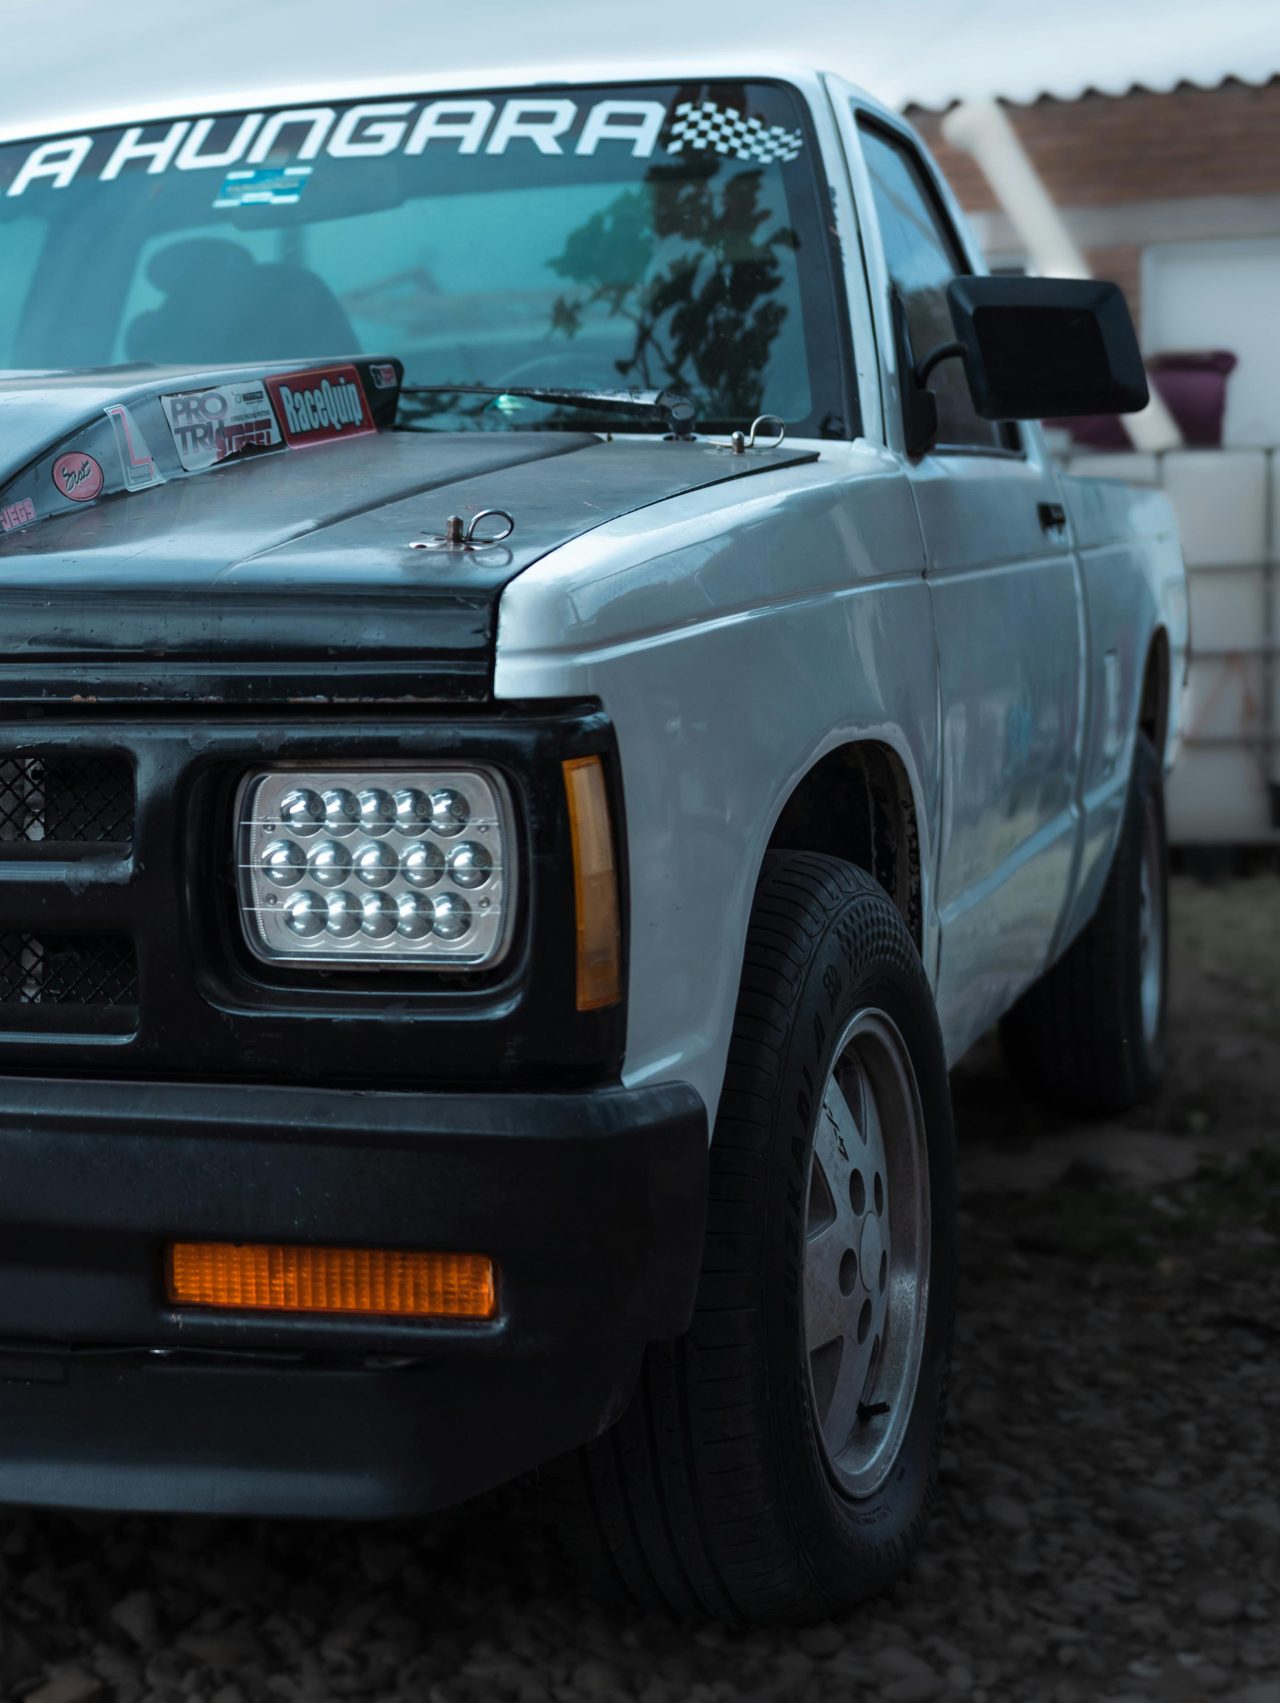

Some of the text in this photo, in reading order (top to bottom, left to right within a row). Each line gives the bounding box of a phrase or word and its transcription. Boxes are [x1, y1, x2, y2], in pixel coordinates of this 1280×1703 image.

[98, 98, 666, 181] HUNGARA
[170, 391, 228, 425] PRO
[278, 377, 364, 435] RaceQuip
[0, 498, 36, 531] JEGS
